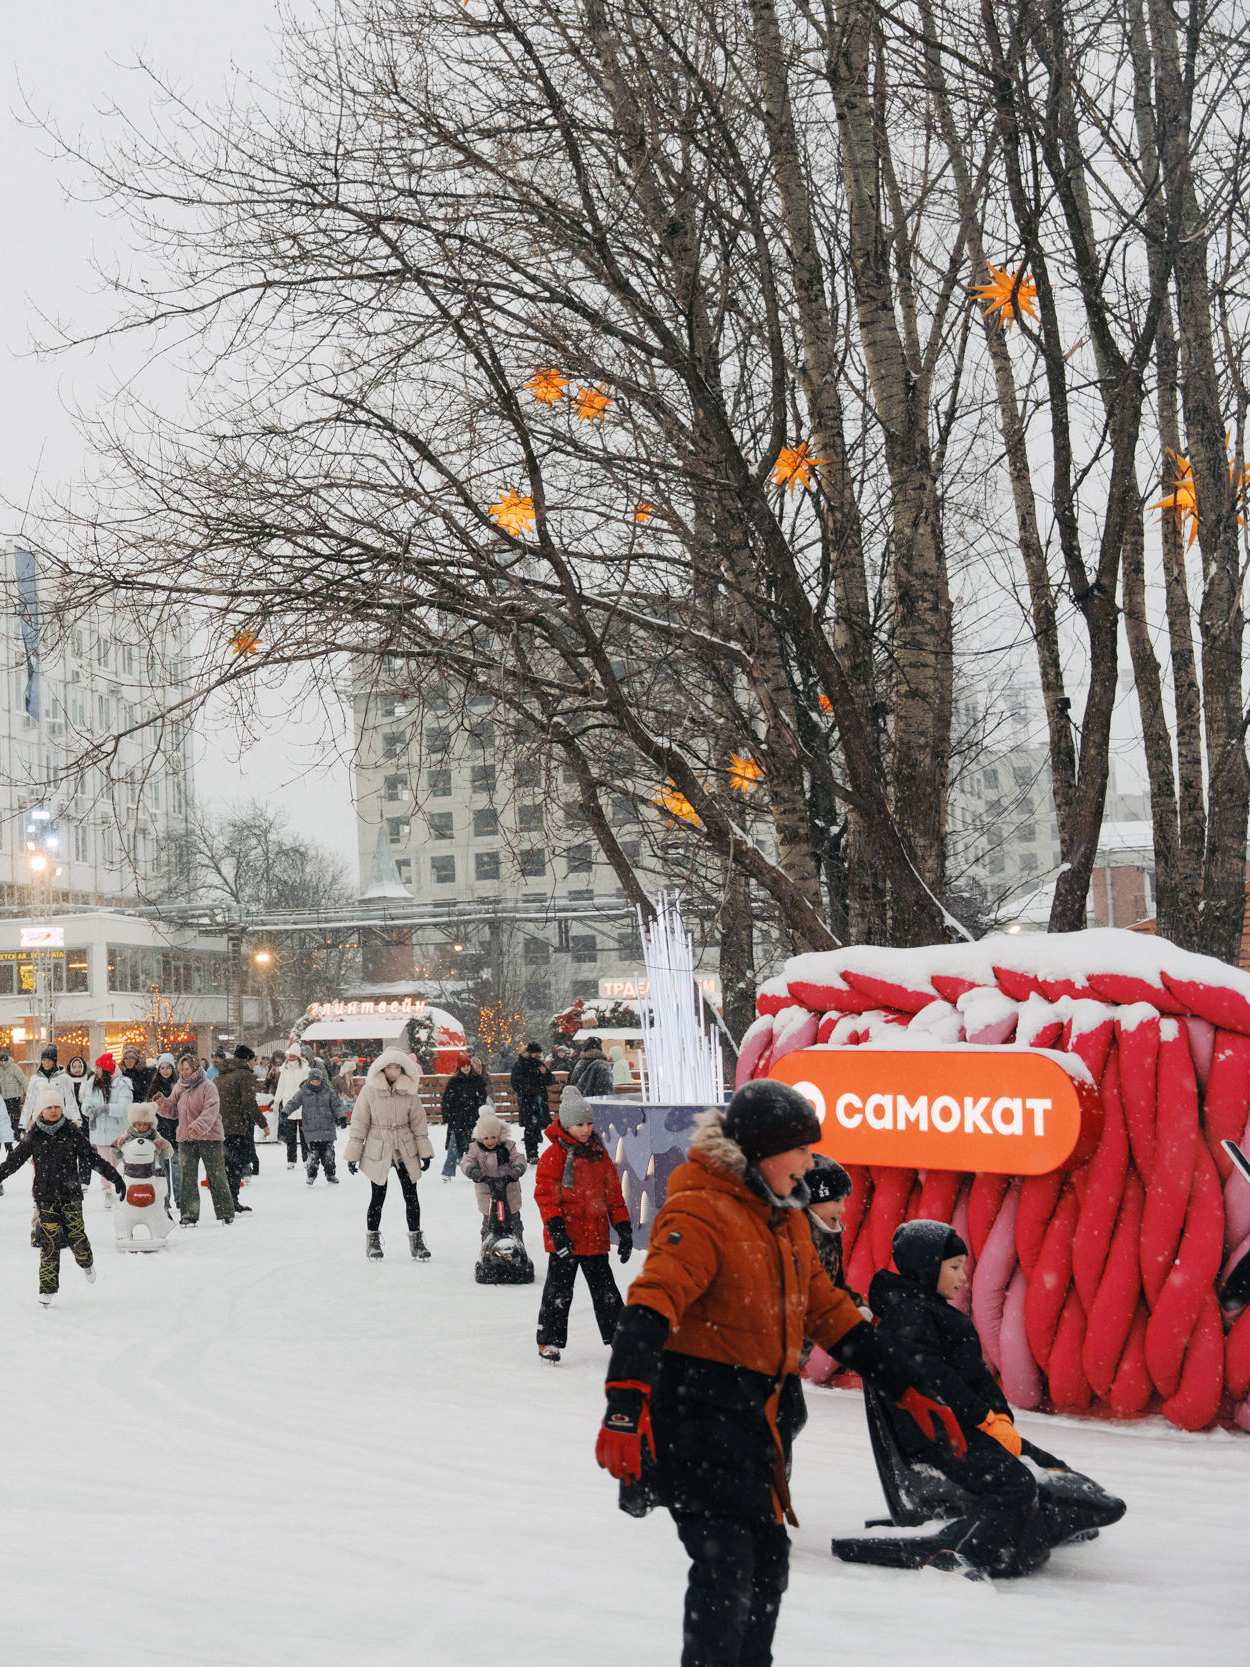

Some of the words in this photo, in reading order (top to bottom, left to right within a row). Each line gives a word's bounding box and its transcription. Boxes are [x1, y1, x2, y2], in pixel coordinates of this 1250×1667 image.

[311, 997, 426, 1016] глинтвейн
[835, 1092, 1053, 1137] самокат
[819, 1189, 830, 1198] 23
